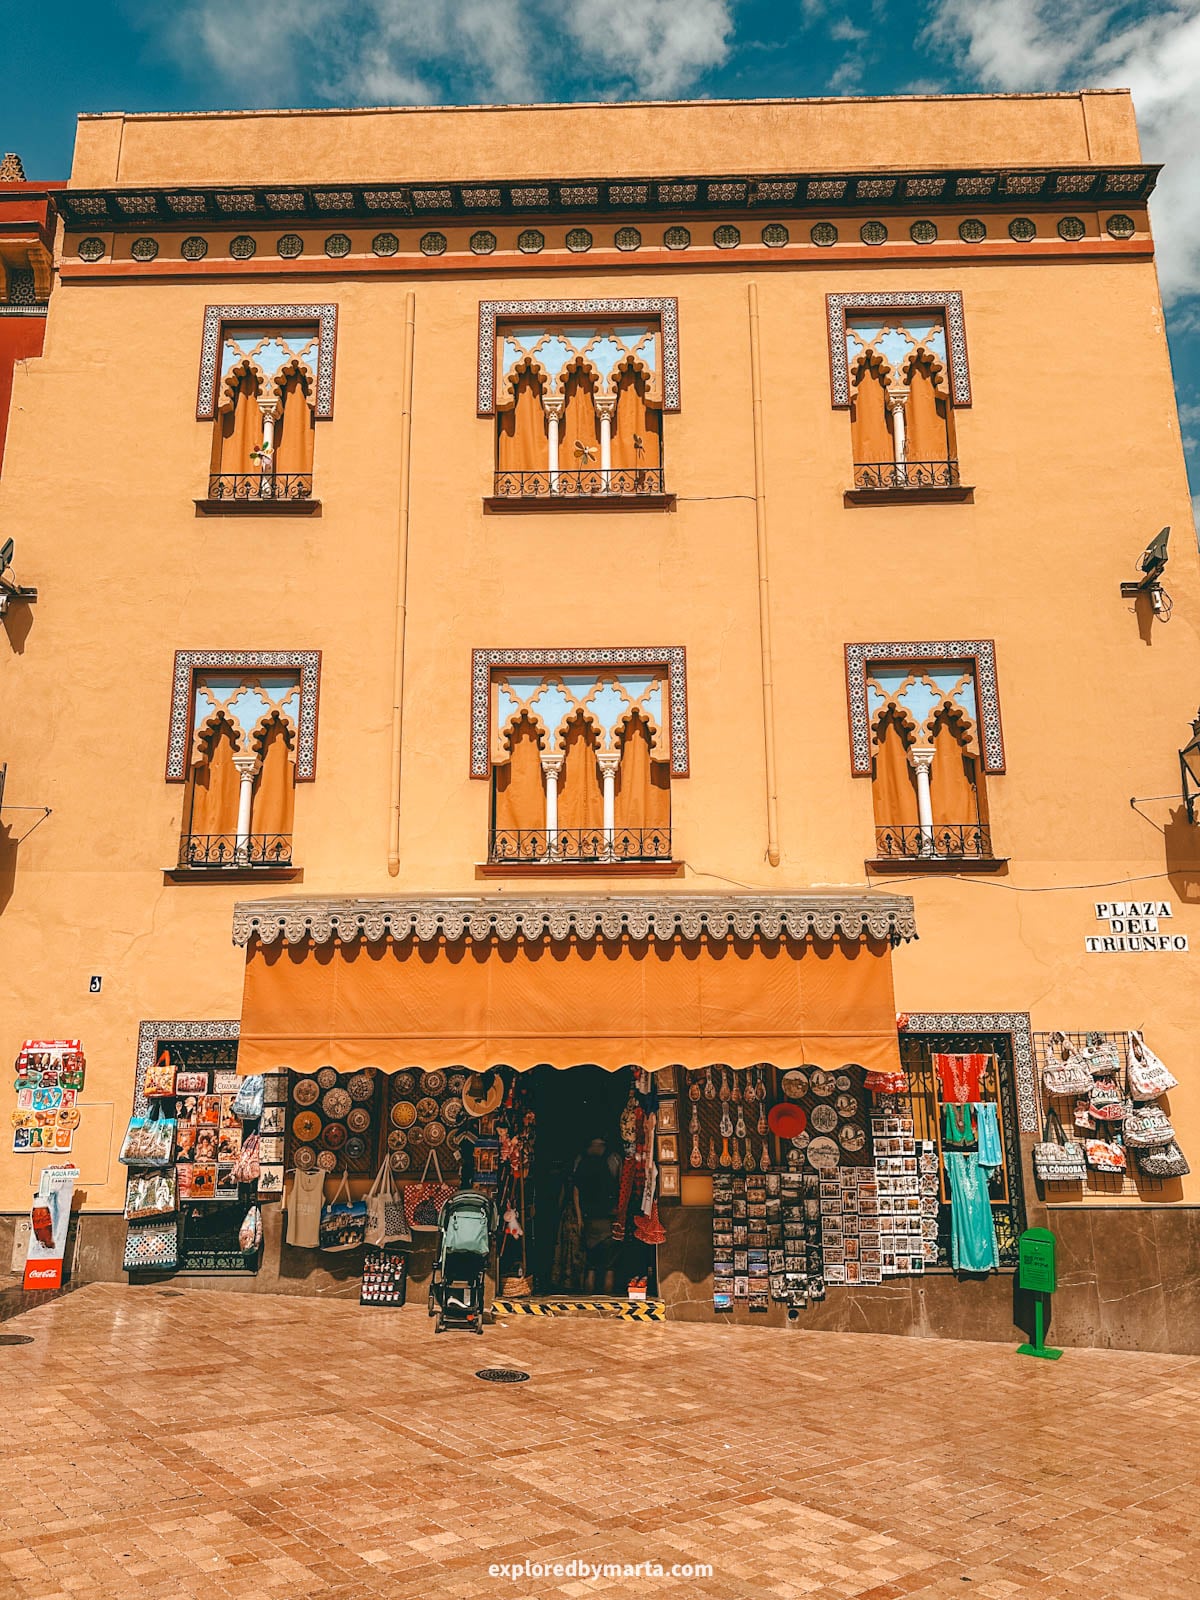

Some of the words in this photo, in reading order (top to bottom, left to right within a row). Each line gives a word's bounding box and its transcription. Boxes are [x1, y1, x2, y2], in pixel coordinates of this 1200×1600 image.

[1095, 902, 1171, 917] PLAZA
[1111, 919, 1157, 934] DEL
[1086, 936, 1186, 951] TRIUNFO
[1049, 1164, 1082, 1174] CÓRDOBA
